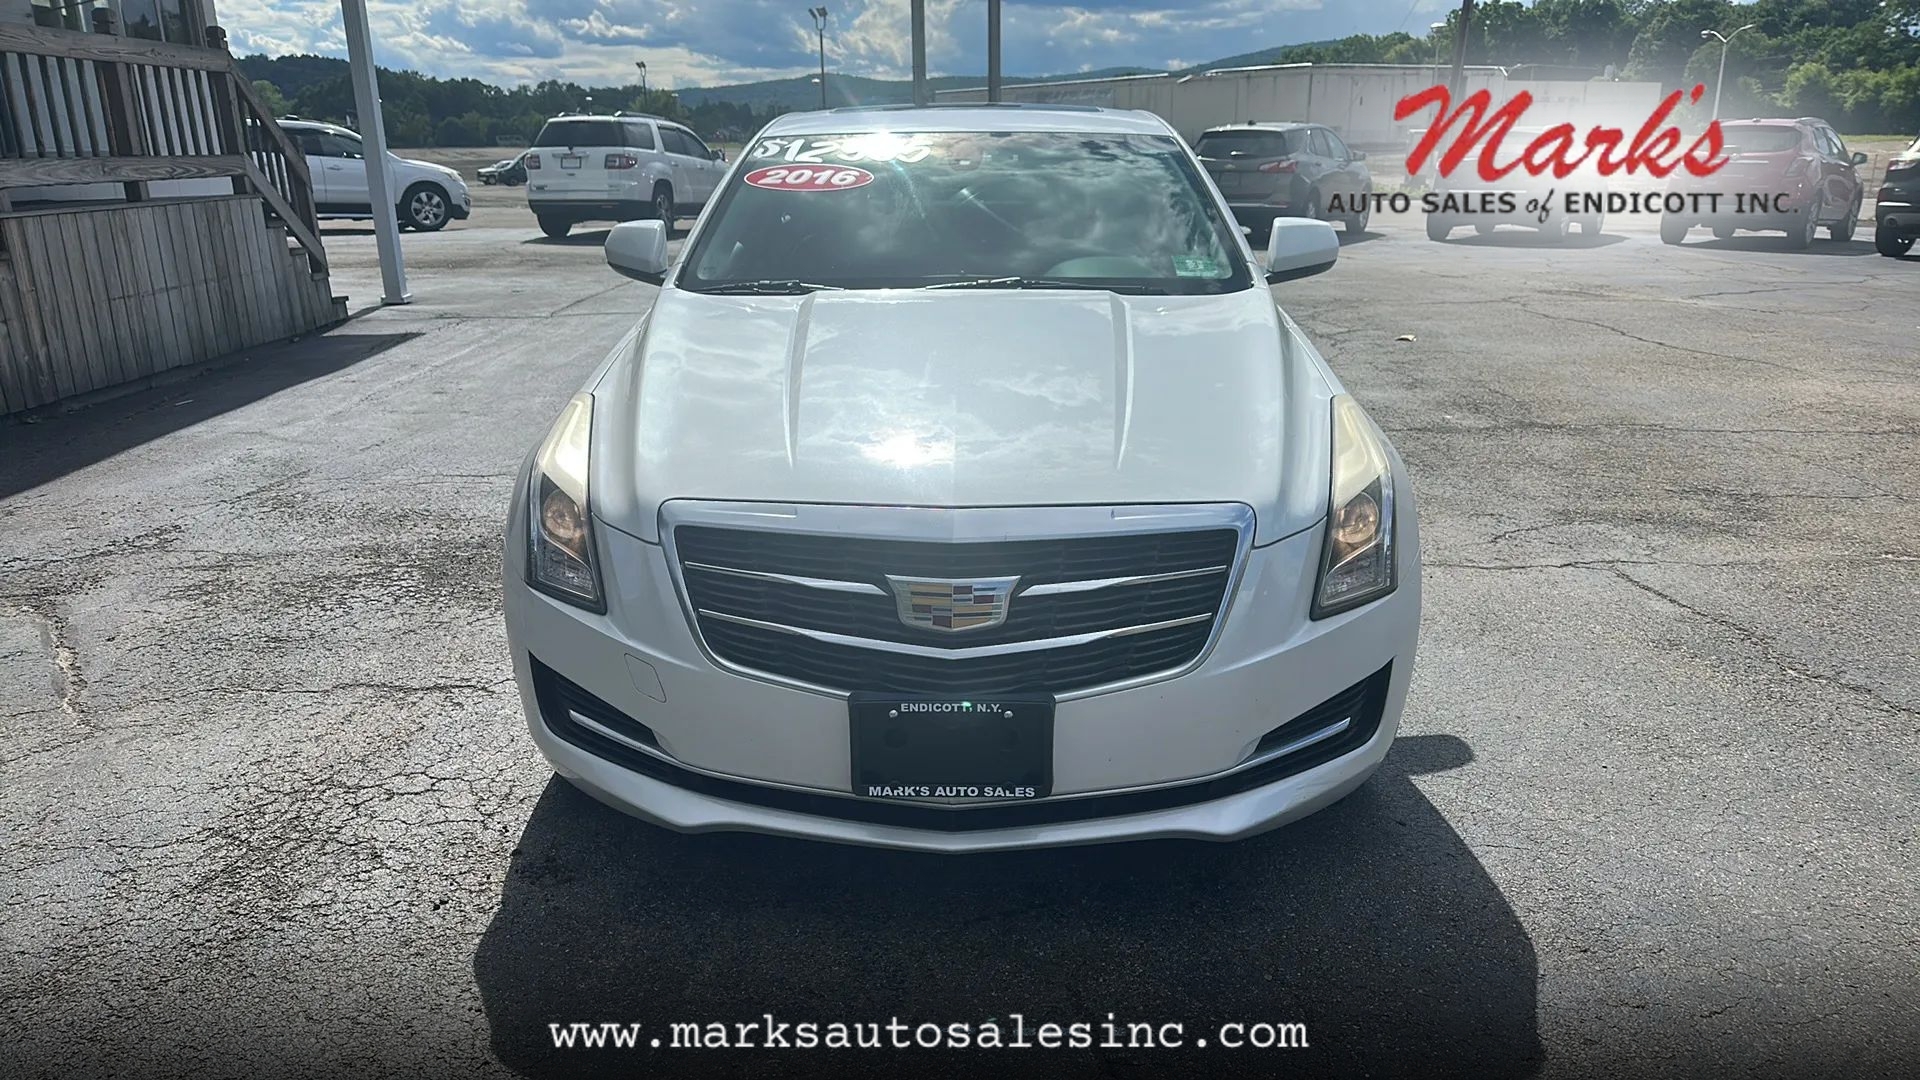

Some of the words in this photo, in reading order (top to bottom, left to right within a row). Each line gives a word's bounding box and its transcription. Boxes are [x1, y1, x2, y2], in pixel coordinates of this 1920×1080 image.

[757, 169, 860, 186] 2016
[977, 703, 1002, 713] N.Y.
[868, 786, 930, 797] MARK'S
[935, 787, 978, 797] AUTO
[983, 787, 1035, 797] SALES
